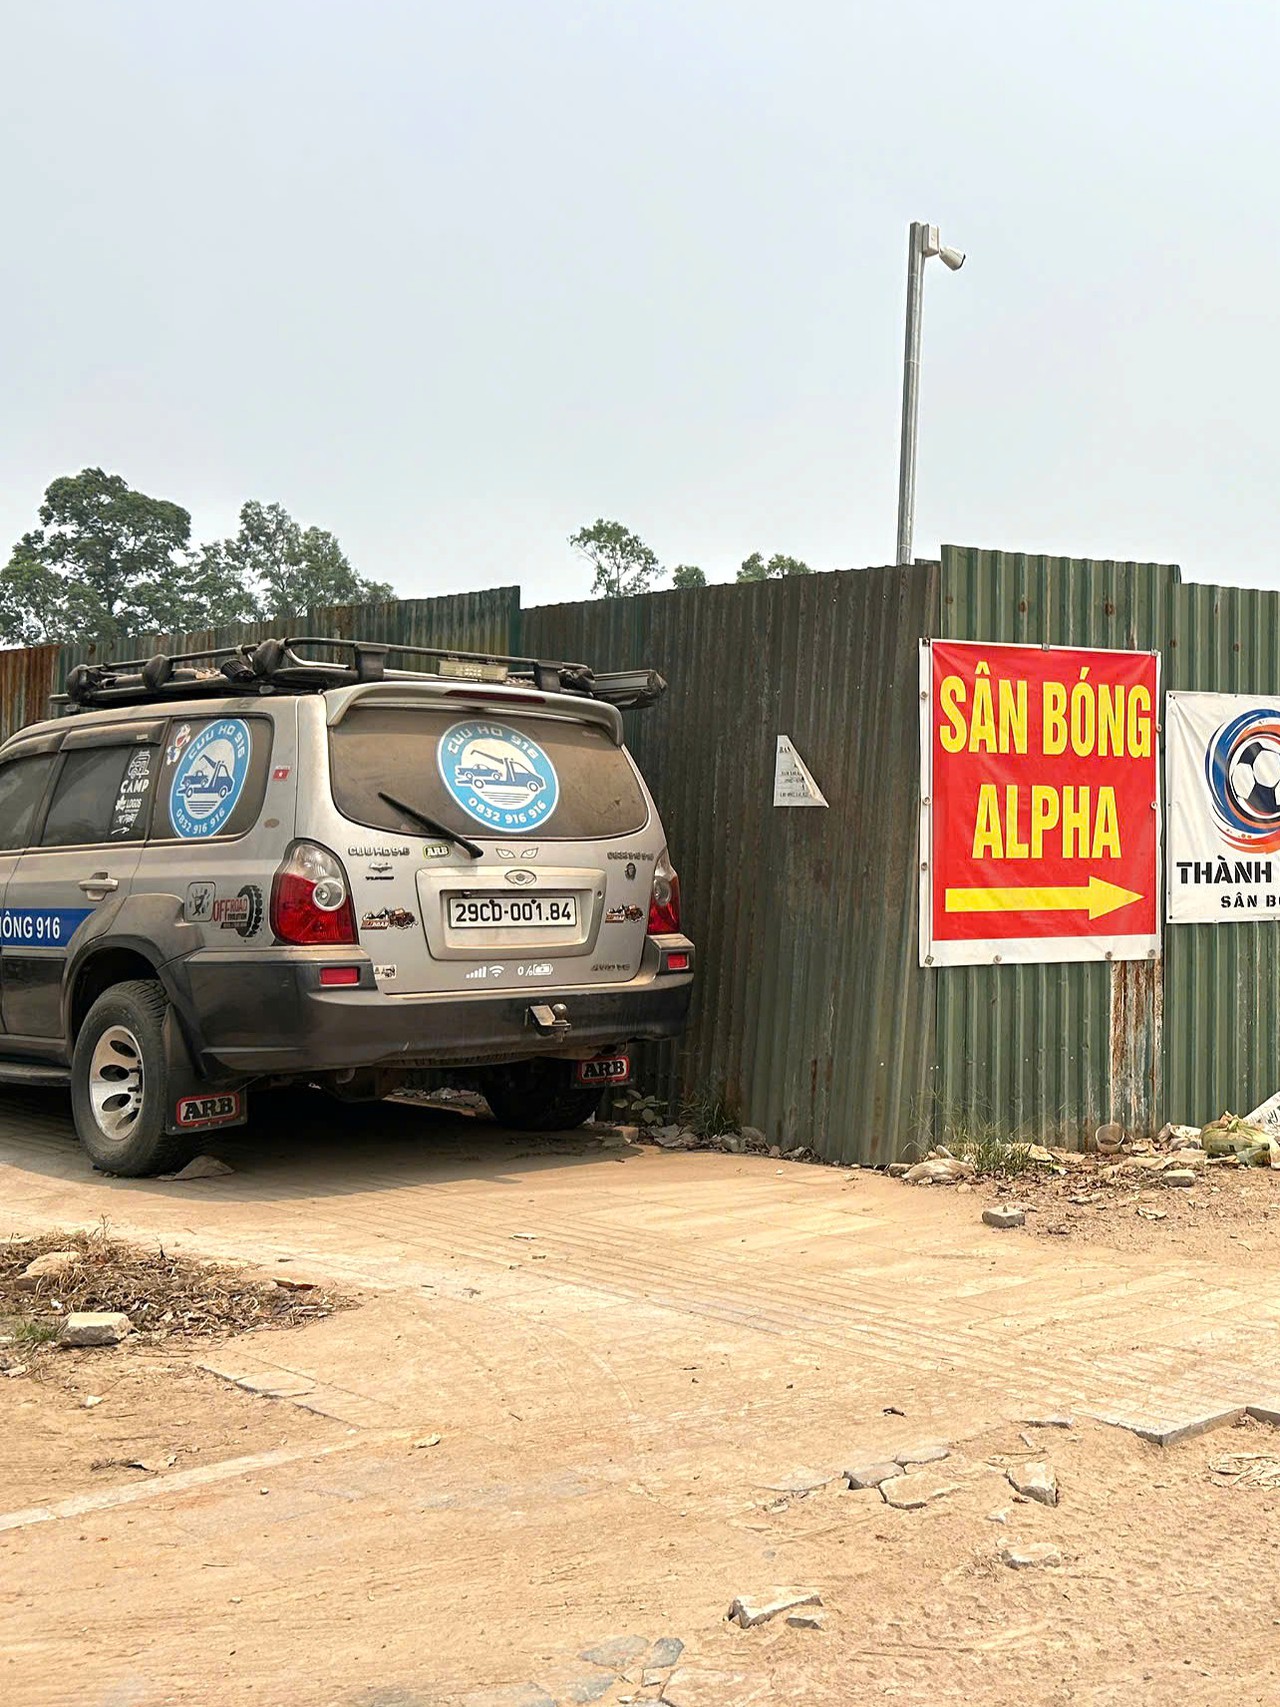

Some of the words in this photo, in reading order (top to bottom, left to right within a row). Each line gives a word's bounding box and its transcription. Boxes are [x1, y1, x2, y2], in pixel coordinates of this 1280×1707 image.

[939, 660, 1028, 754] SÂN
[1042, 666, 1152, 759] BÓNG
[233, 731, 246, 759] 916
[510, 734, 539, 760] 916
[120, 779, 150, 794] CAMP
[175, 808, 192, 833] 0832
[193, 824, 208, 835] 916
[209, 808, 226, 828] 916
[467, 797, 501, 822] 0832
[504, 813, 527, 825] 916
[528, 800, 547, 819] 916
[972, 784, 1122, 859] ALPHA
[426, 846, 449, 857] ARB
[1176, 855, 1273, 884] THÀNH
[455, 902, 572, 922] 29CD-001.84
[1220, 892, 1258, 909] SÂN
[0, 910, 33, 939] ÔNG
[36, 916, 60, 939] 916
[583, 1061, 625, 1078] ARB
[183, 1097, 234, 1121] ARB
